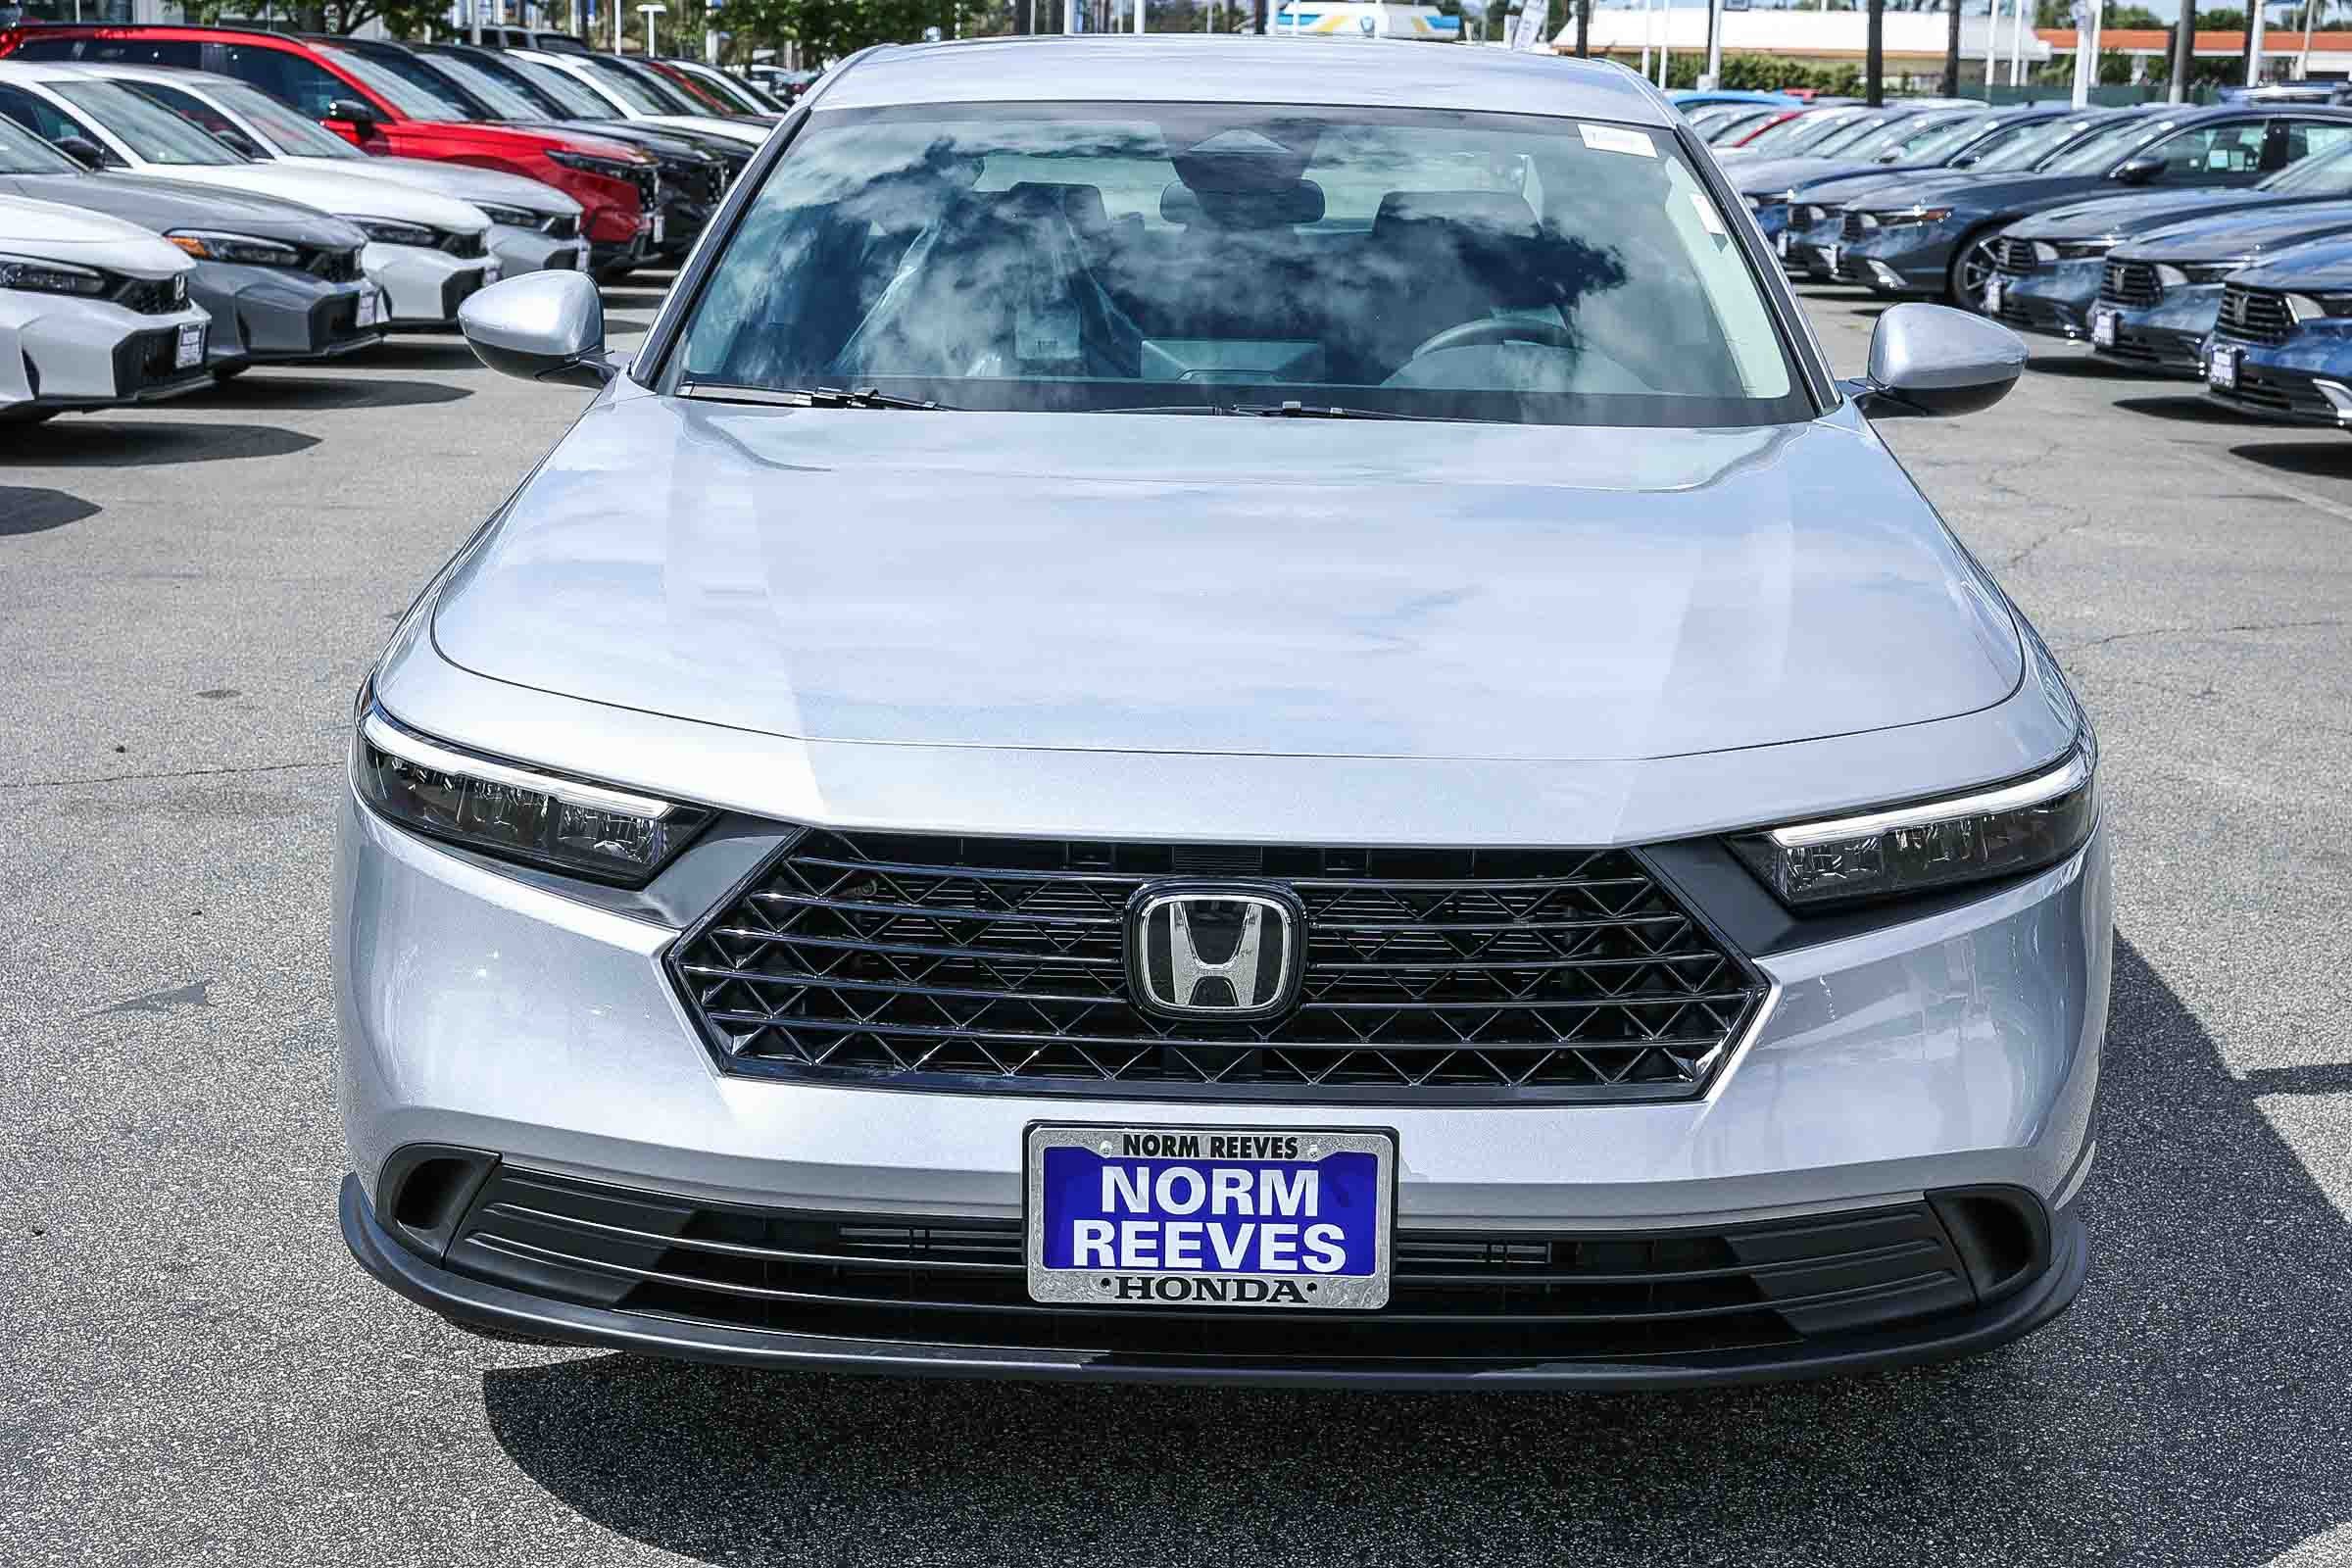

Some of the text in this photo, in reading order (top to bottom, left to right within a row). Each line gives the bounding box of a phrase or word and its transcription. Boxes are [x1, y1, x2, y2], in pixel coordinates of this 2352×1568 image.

[1123, 1134, 1298, 1160] NORM REEVES
[1101, 1165, 1320, 1217] NORM
[1072, 1218, 1348, 1273] REEVES
[1114, 1276, 1308, 1304] HONDA
